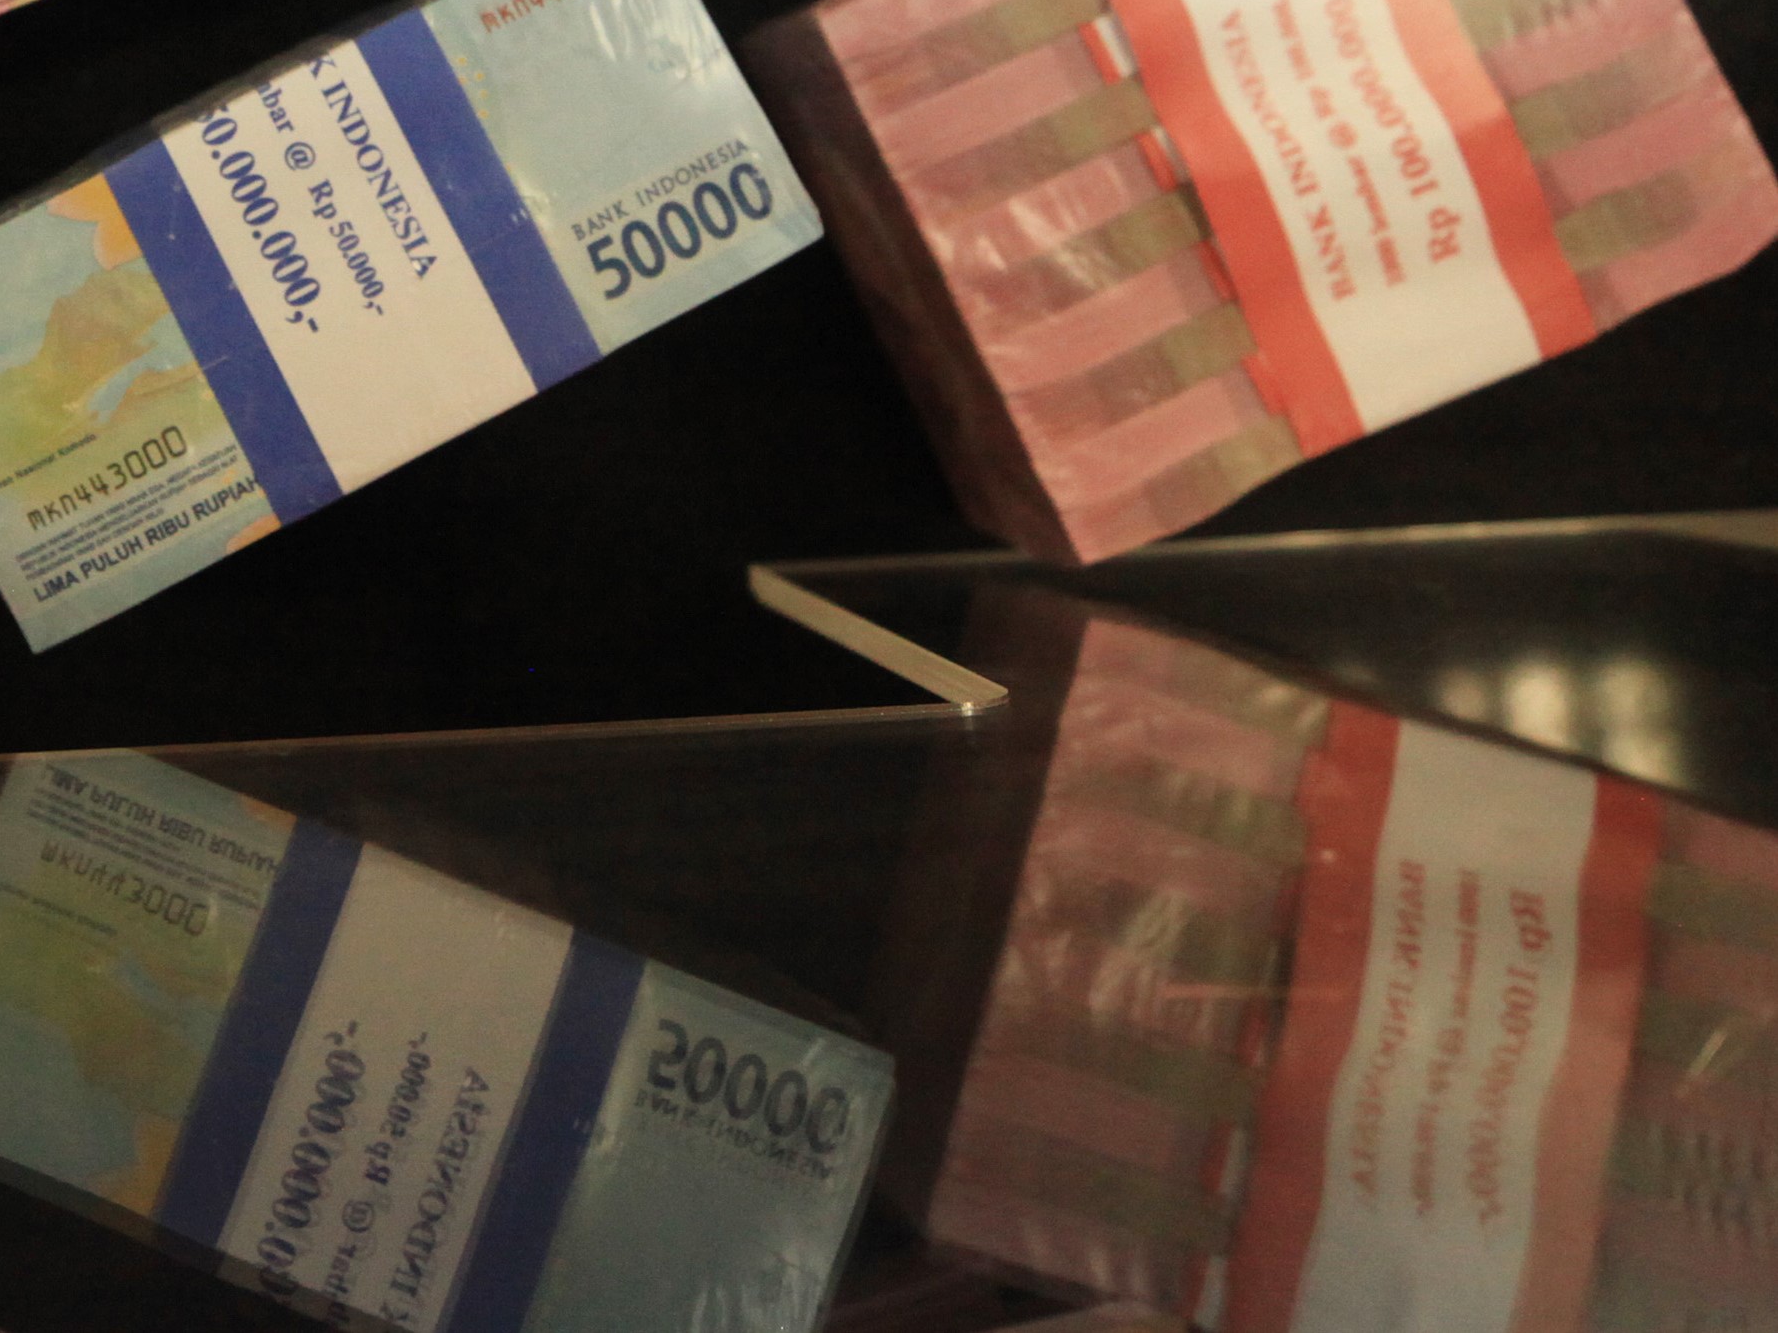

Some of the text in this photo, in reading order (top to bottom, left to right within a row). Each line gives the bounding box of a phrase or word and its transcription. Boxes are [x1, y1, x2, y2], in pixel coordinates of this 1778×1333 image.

[284, 140, 316, 172] @
[307, 178, 338, 221] Rp
[321, 79, 437, 280] INDONESIA
[571, 137, 750, 243] BANK INDONESIA
[585, 161, 774, 302] 50000
[1428, 206, 1463, 264] Rp
[32, 570, 80, 603] LIMA
[79, 535, 145, 580] PULUH
[145, 511, 191, 547] RIBU
[190, 475, 261, 523] RUPIAH
